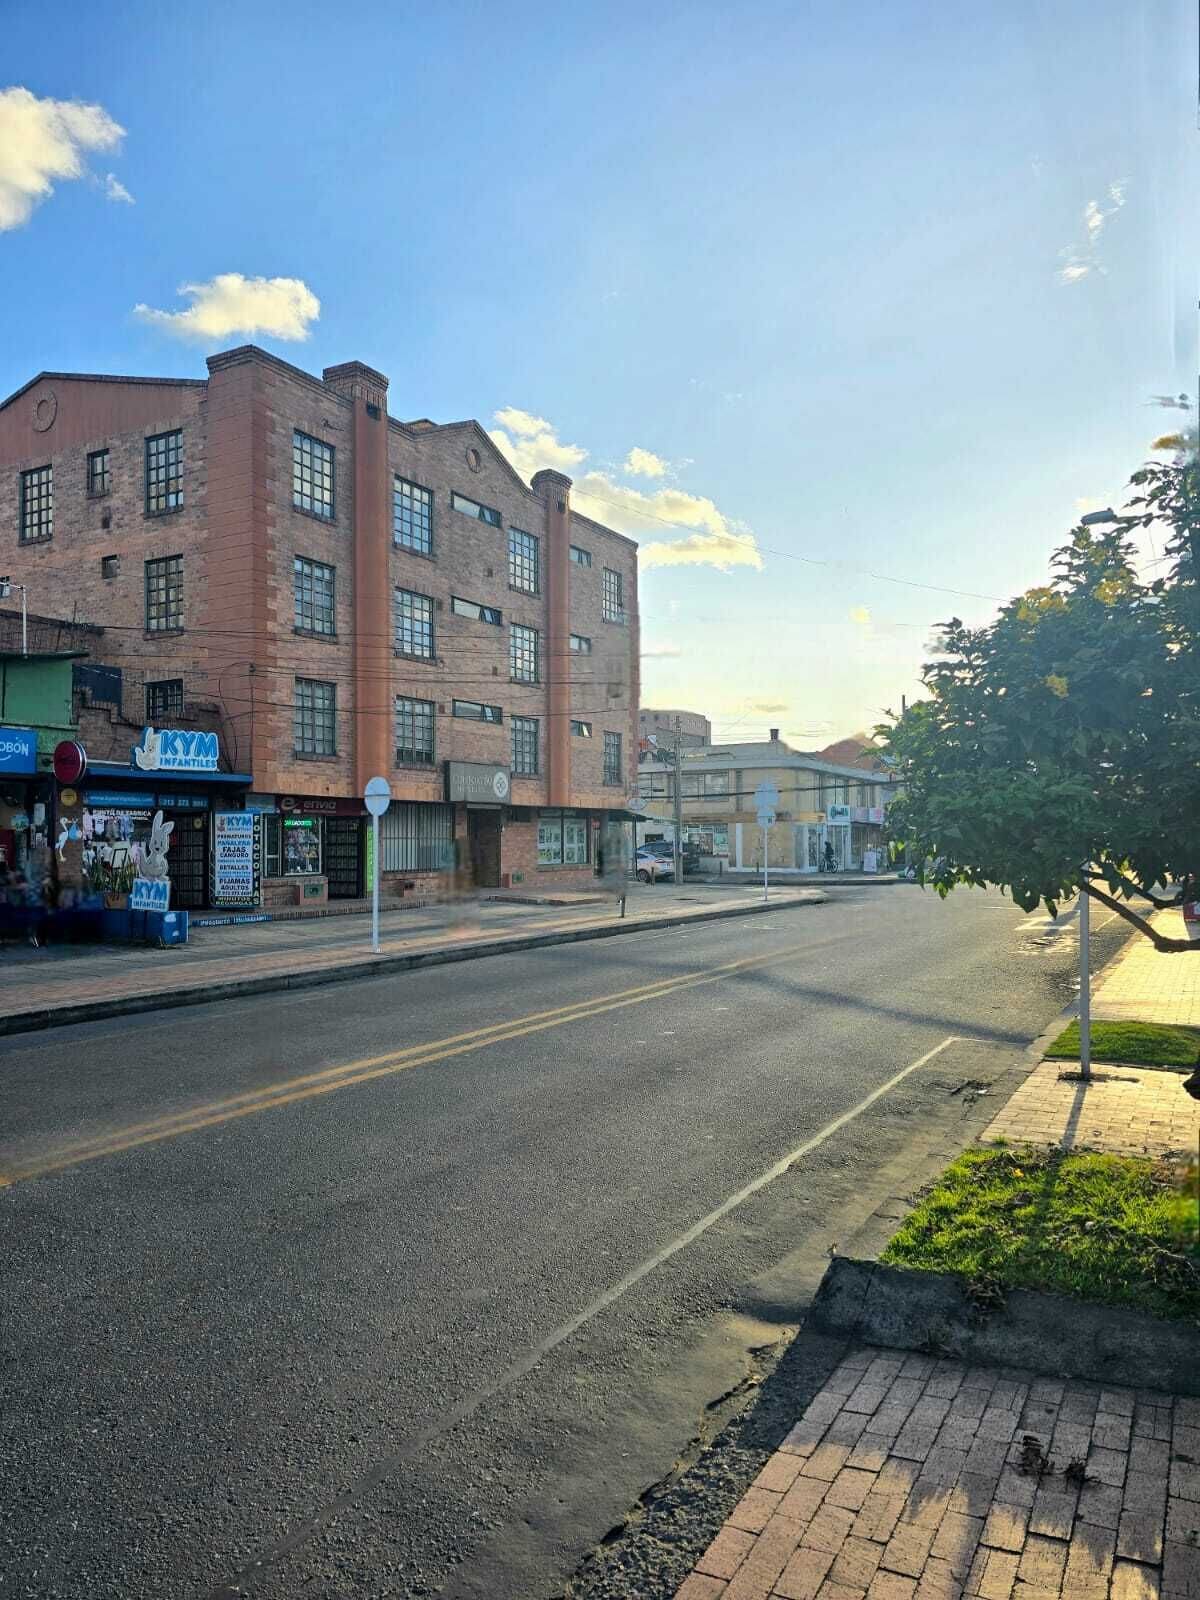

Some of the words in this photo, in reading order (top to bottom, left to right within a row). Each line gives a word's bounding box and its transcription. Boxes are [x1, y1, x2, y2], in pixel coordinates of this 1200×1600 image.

[160, 731, 218, 758] KYM
[160, 757, 217, 768] INFANTILES
[227, 816, 252, 826] KYM
[135, 881, 167, 901] KYM
